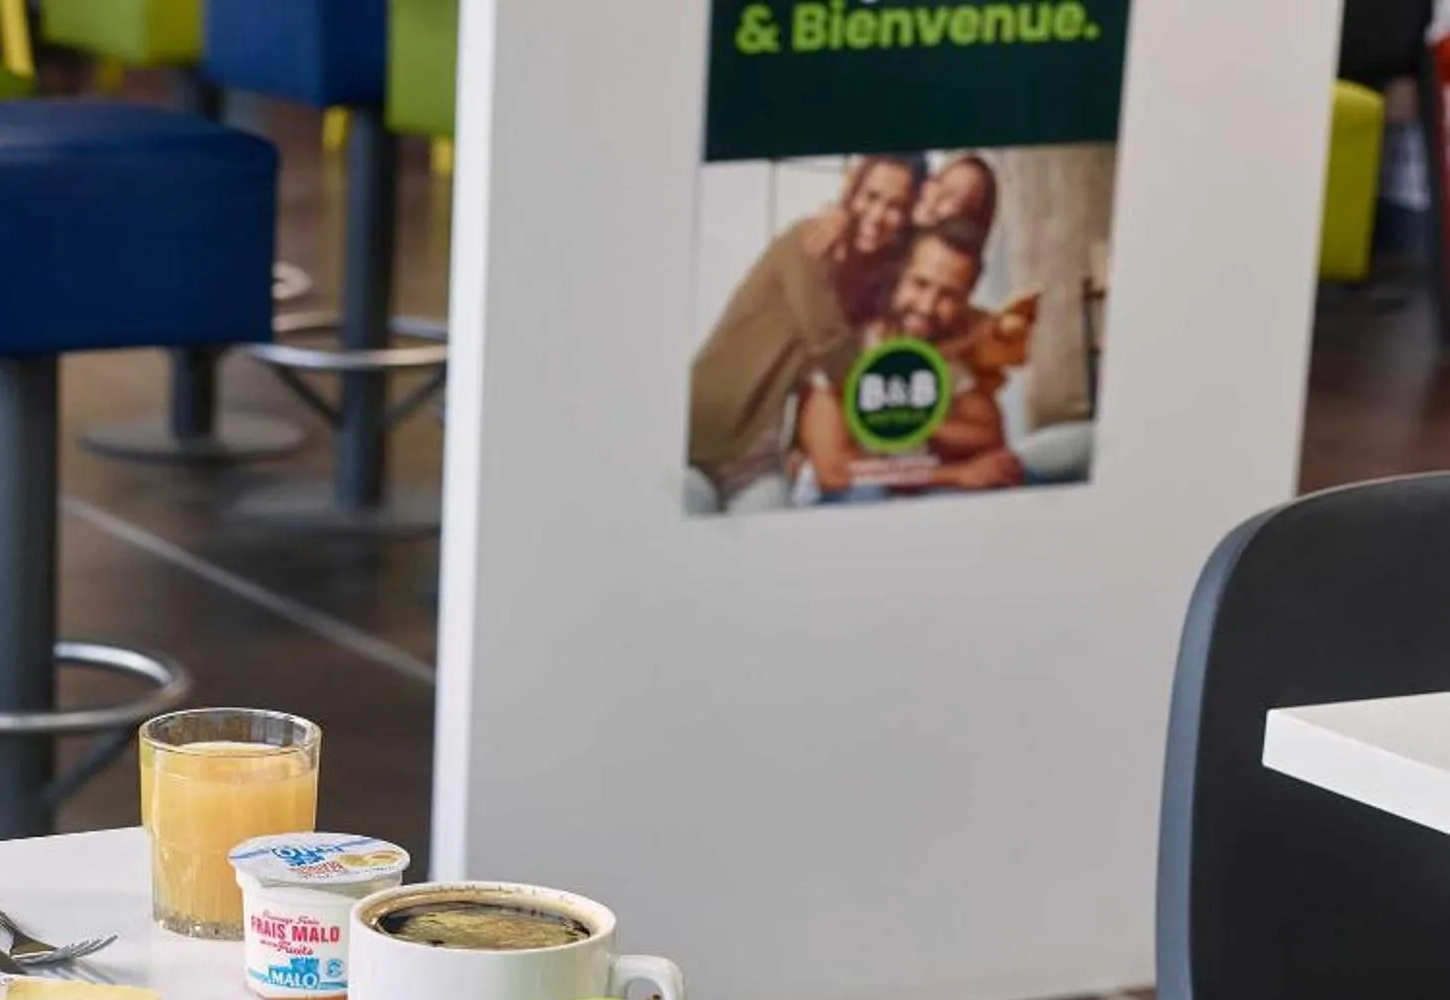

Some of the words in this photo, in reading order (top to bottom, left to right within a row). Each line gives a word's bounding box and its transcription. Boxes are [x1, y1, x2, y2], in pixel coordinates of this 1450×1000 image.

[735, 3, 780, 54] &
[792, 0, 1100, 52] Bienvenue.
[858, 369, 938, 412] B&B
[251, 915, 287, 940] FRAIS
[292, 925, 340, 944] MALO
[270, 969, 318, 989] MALO
